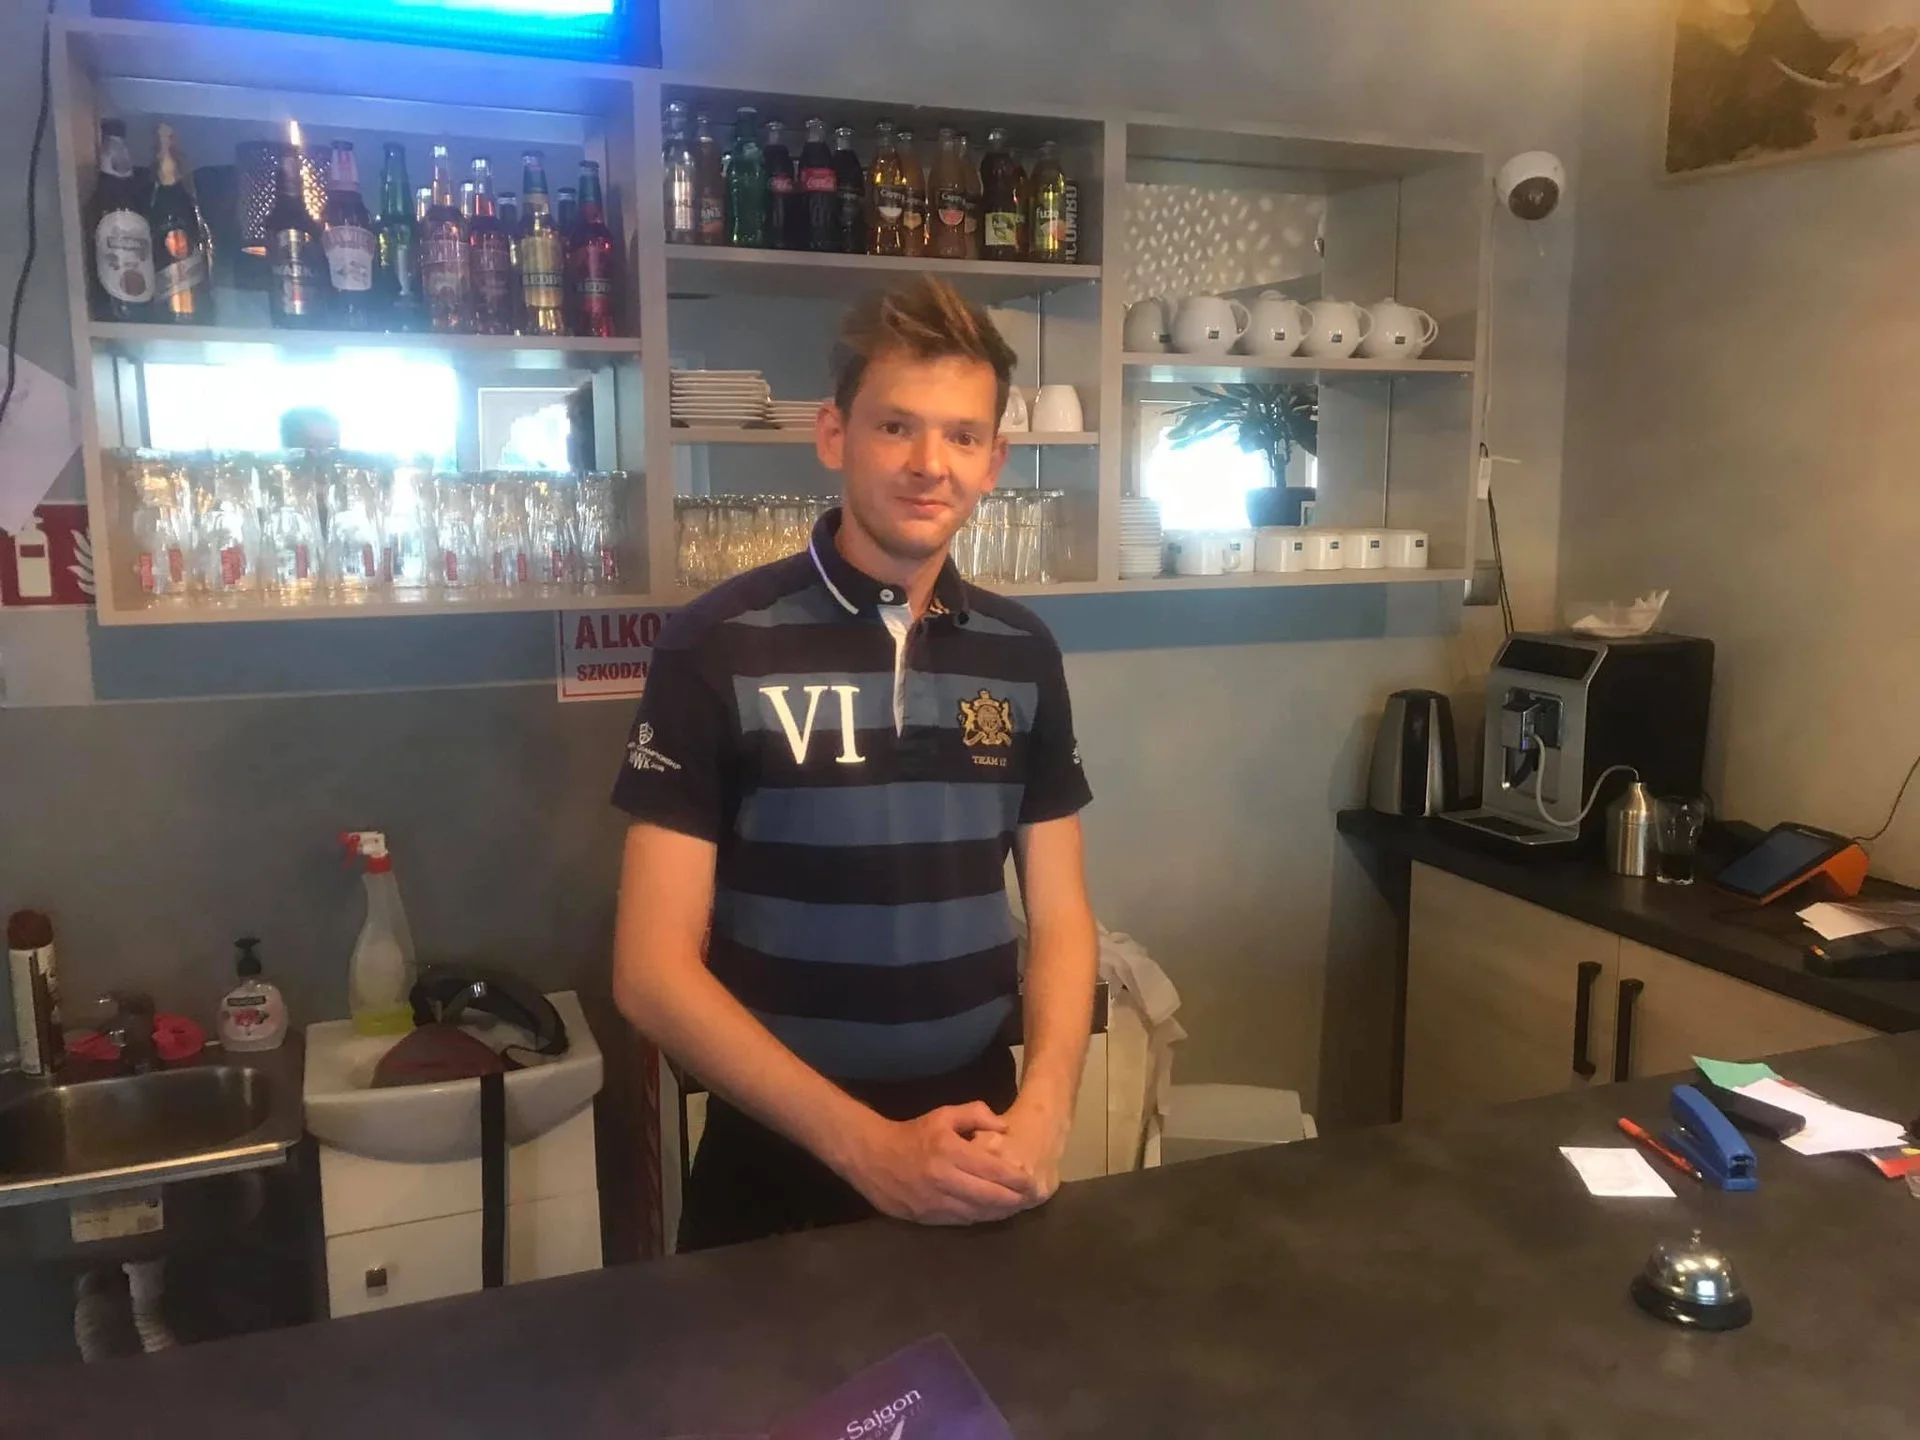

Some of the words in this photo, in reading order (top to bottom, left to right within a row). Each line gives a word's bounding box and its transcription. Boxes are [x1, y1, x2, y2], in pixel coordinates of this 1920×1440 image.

[575, 612, 671, 650] ALKO
[758, 685, 867, 765] VI
[972, 755, 999, 766] TEAM
[846, 1389, 921, 1440] Sajgon
